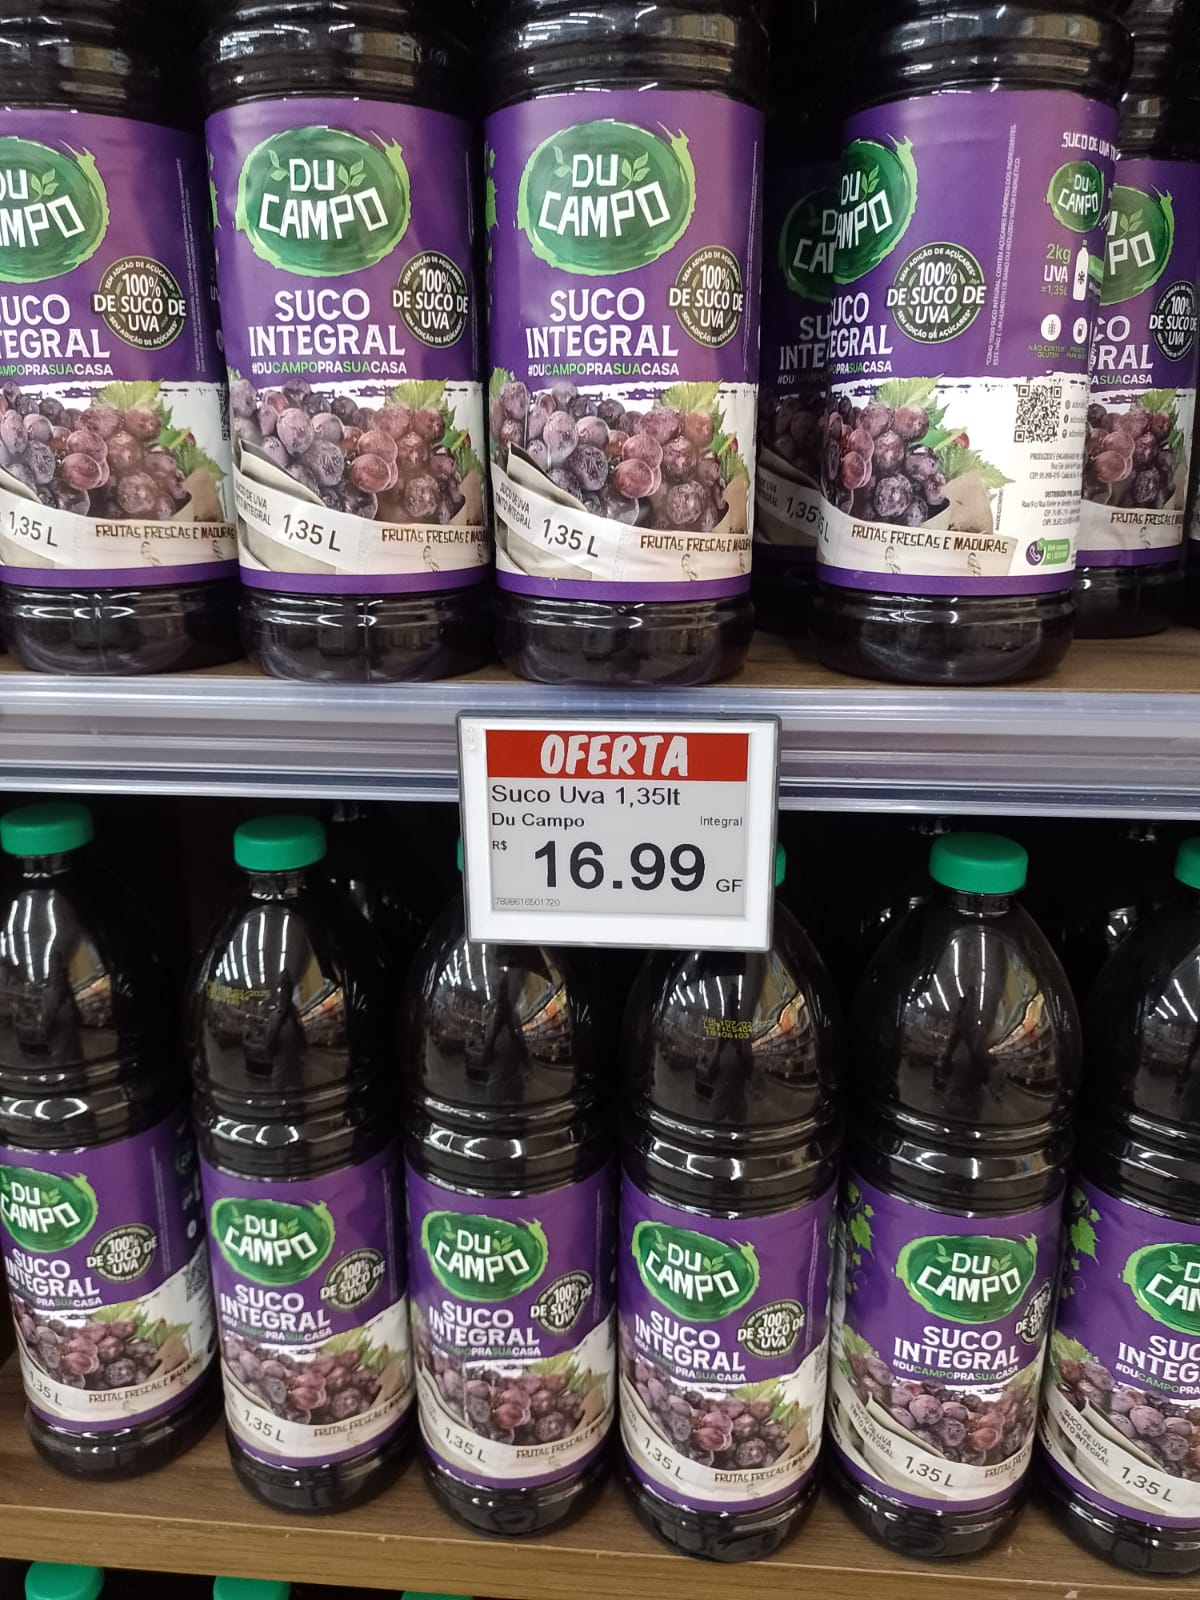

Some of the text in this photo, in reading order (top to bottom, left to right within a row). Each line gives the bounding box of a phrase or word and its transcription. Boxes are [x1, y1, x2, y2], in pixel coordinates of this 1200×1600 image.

[1062, 132, 1087, 149] SUCO
[289, 159, 335, 192] DU
[572, 154, 618, 188] DU
[1073, 174, 1089, 192] DU
[840, 171, 860, 205] DU
[1058, 188, 1099, 215] CAMPO
[0, 195, 85, 248] MPO
[259, 187, 388, 240] CAMPO
[538, 181, 670, 238] CAMPO
[835, 190, 892, 249] AMPO
[1046, 243, 1071, 264] 2kg
[122, 273, 161, 297] 100%
[419, 268, 452, 293] 100%
[700, 264, 730, 290] 100%
[918, 262, 957, 286] 100%
[1044, 265, 1068, 282] UVA
[0, 294, 70, 325] UCO
[94, 294, 186, 316] DE SUCO DE
[274, 289, 370, 321] SUCO
[393, 289, 468, 314] DE SUCO DE
[549, 287, 646, 321] SUCO
[669, 288, 743, 312] DE SUCO DE
[832, 293, 868, 326] UCO
[887, 286, 986, 307] DE SUCO DE
[128, 314, 160, 332] UVA
[421, 311, 449, 329] UVA
[700, 309, 724, 329] UVA
[915, 305, 949, 324] UVA
[1149, 314, 1163, 330] DE
[1165, 314, 1189, 331] SUCO
[0, 328, 110, 358] EGRAL
[248, 324, 405, 357] INTEGRAL
[526, 325, 679, 358] INTEGRAL
[830, 325, 893, 358] EGRAL
[252, 361, 407, 374] #DUCAMPOPRASUACASA
[528, 362, 679, 376] #DUCAMPOPRASUACASA
[787, 497, 818, 523] 1,35
[1111, 512, 1144, 525] FRUTAS
[9, 511, 58, 547] 1,35 L
[95, 524, 235, 540] FRUTAS FRESCAS E MADURAS
[283, 514, 341, 552] 1,35 L
[382, 528, 421, 543] FRUTAS
[426, 530, 464, 543] FRESCAS
[542, 518, 599, 557] 1,35 L
[641, 535, 684, 551] FRUTAS
[686, 538, 725, 552] FRESCAS
[851, 524, 1008, 554] FRUTAS FRESCAS E MADURAS
[540, 733, 689, 777] OFERTA
[491, 784, 681, 808] Suco Uva 1,35lt
[491, 812, 585, 830] Du Campo
[700, 816, 743, 828] Integral
[492, 840, 508, 851] R$
[534, 840, 705, 892] 16.99
[716, 878, 743, 893] GF
[11, 1181, 40, 1206] DU
[0, 1192, 81, 1233] CAMPO
[245, 1214, 278, 1238] DU
[86, 1236, 158, 1268] DE SUCO DE
[108, 1234, 138, 1252] 100%
[225, 1226, 318, 1266] CAMPO
[457, 1229, 492, 1254] DU
[12, 1248, 71, 1279] SUCO
[112, 1259, 140, 1275] UVA
[434, 1239, 530, 1284] CAMPO
[667, 1242, 701, 1271] DU
[951, 1252, 991, 1275] DU
[4, 1256, 100, 1298] INTEGRAL
[645, 1249, 740, 1302] CAMPO
[917, 1265, 1021, 1303] CAMPO
[220, 1292, 331, 1333] INTEGRAL
[234, 1284, 304, 1313] SUCO
[428, 1305, 541, 1348] INTEGRAL
[442, 1300, 514, 1330] SUCO
[737, 1315, 805, 1341] DE SUCO DE
[761, 1311, 791, 1328] 100%
[634, 1312, 746, 1373] INTEGRAL
[650, 1311, 721, 1350] SUCO
[761, 1336, 787, 1348] UVA
[923, 1325, 1003, 1351] SUCO
[893, 1337, 1020, 1371] INTEGRAL
[1118, 1341, 1200, 1383] INTEG
[1148, 1335, 1200, 1361] SUC
[892, 1359, 1019, 1381] #DUCAMPOPRASUACASA
[29, 1372, 63, 1406] 1,35 L
[243, 1409, 285, 1444] 1,35 L
[442, 1426, 486, 1464] 1,35 L
[642, 1436, 685, 1481] 1,35 L
[1075, 1432, 1109, 1467] INTEGRAL
[1092, 1440, 1107, 1456] UVA
[904, 1456, 954, 1488] 1,35 L
[1120, 1466, 1173, 1503] 1,35 L
